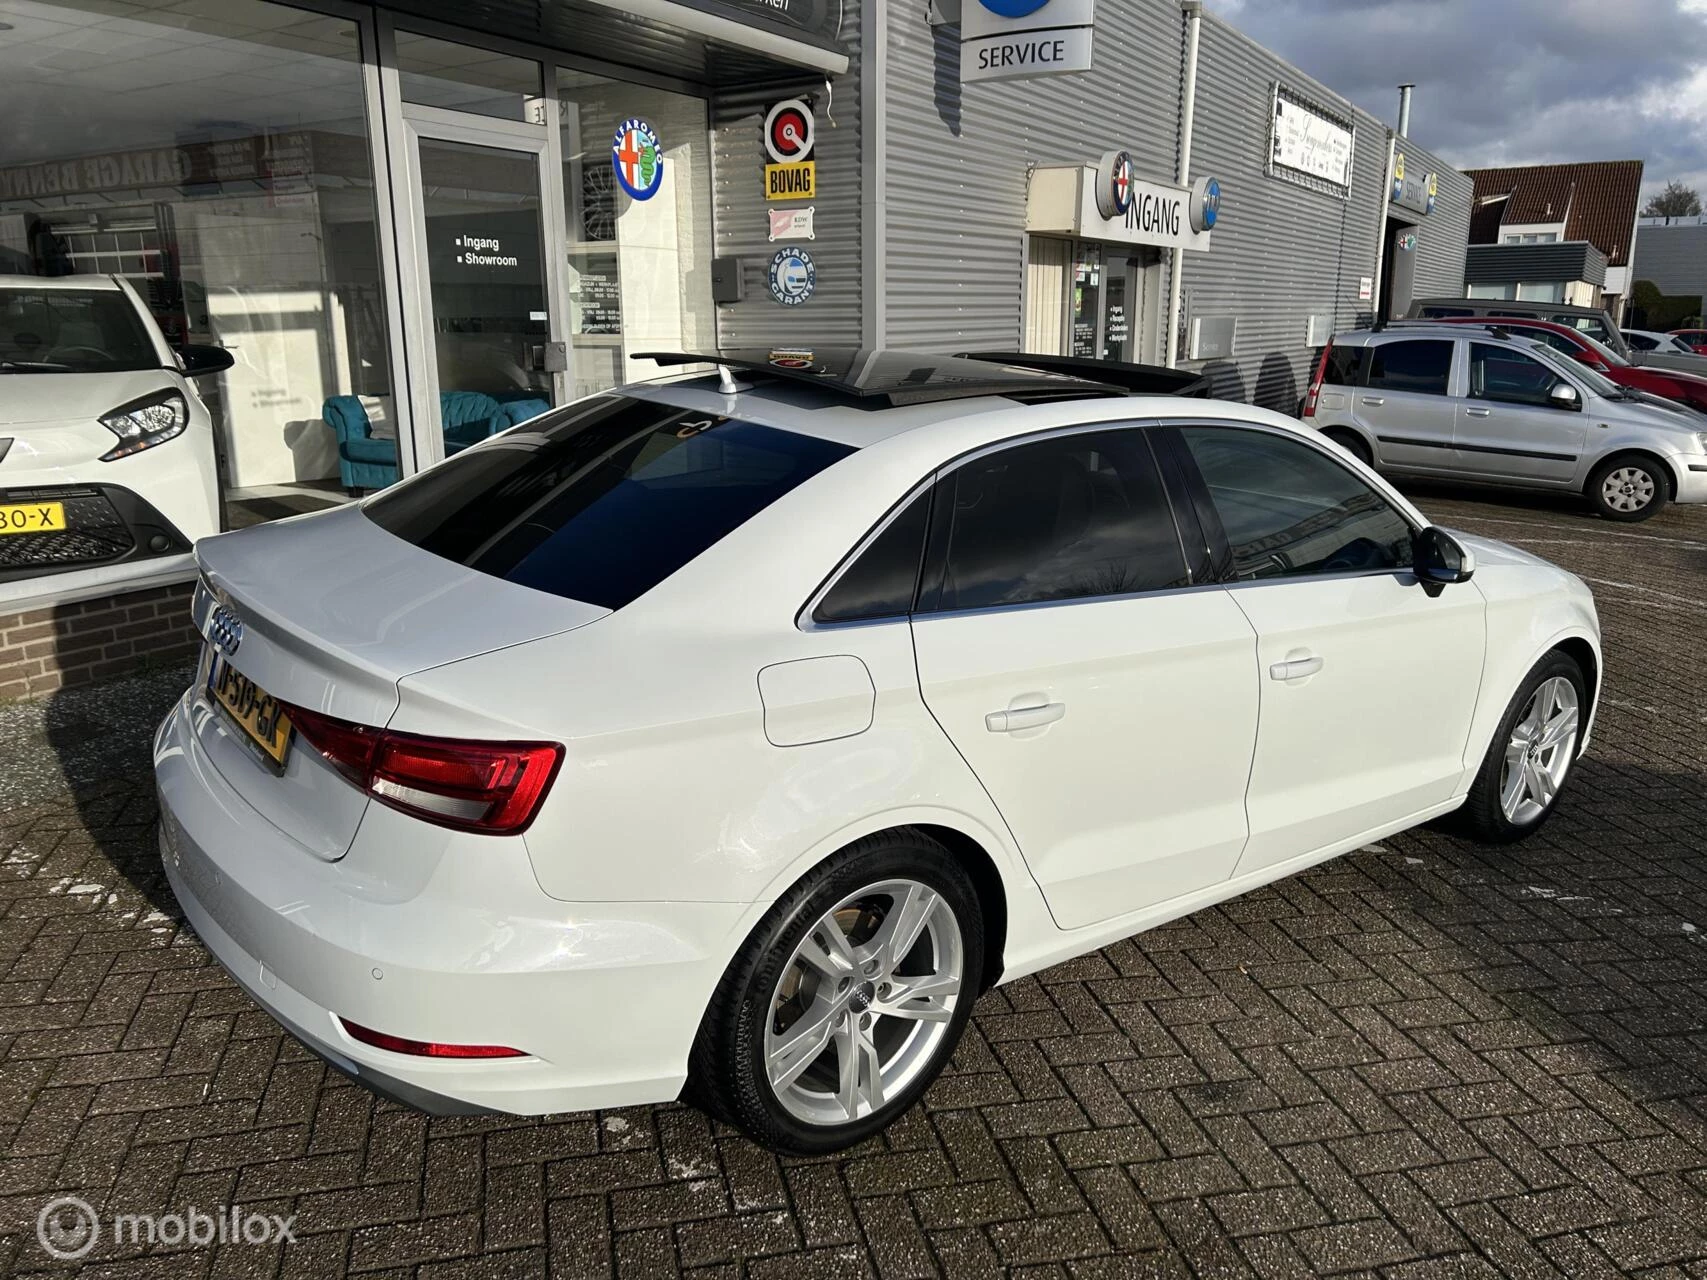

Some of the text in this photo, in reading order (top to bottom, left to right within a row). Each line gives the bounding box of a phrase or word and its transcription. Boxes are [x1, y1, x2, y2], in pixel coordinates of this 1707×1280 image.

[978, 40, 1064, 70] SERVICE
[769, 167, 812, 194] BOVAG
[463, 234, 500, 252] Ingang
[465, 252, 518, 267] Showroom
[770, 247, 815, 275] SCHADE
[771, 280, 814, 305] GARANT
